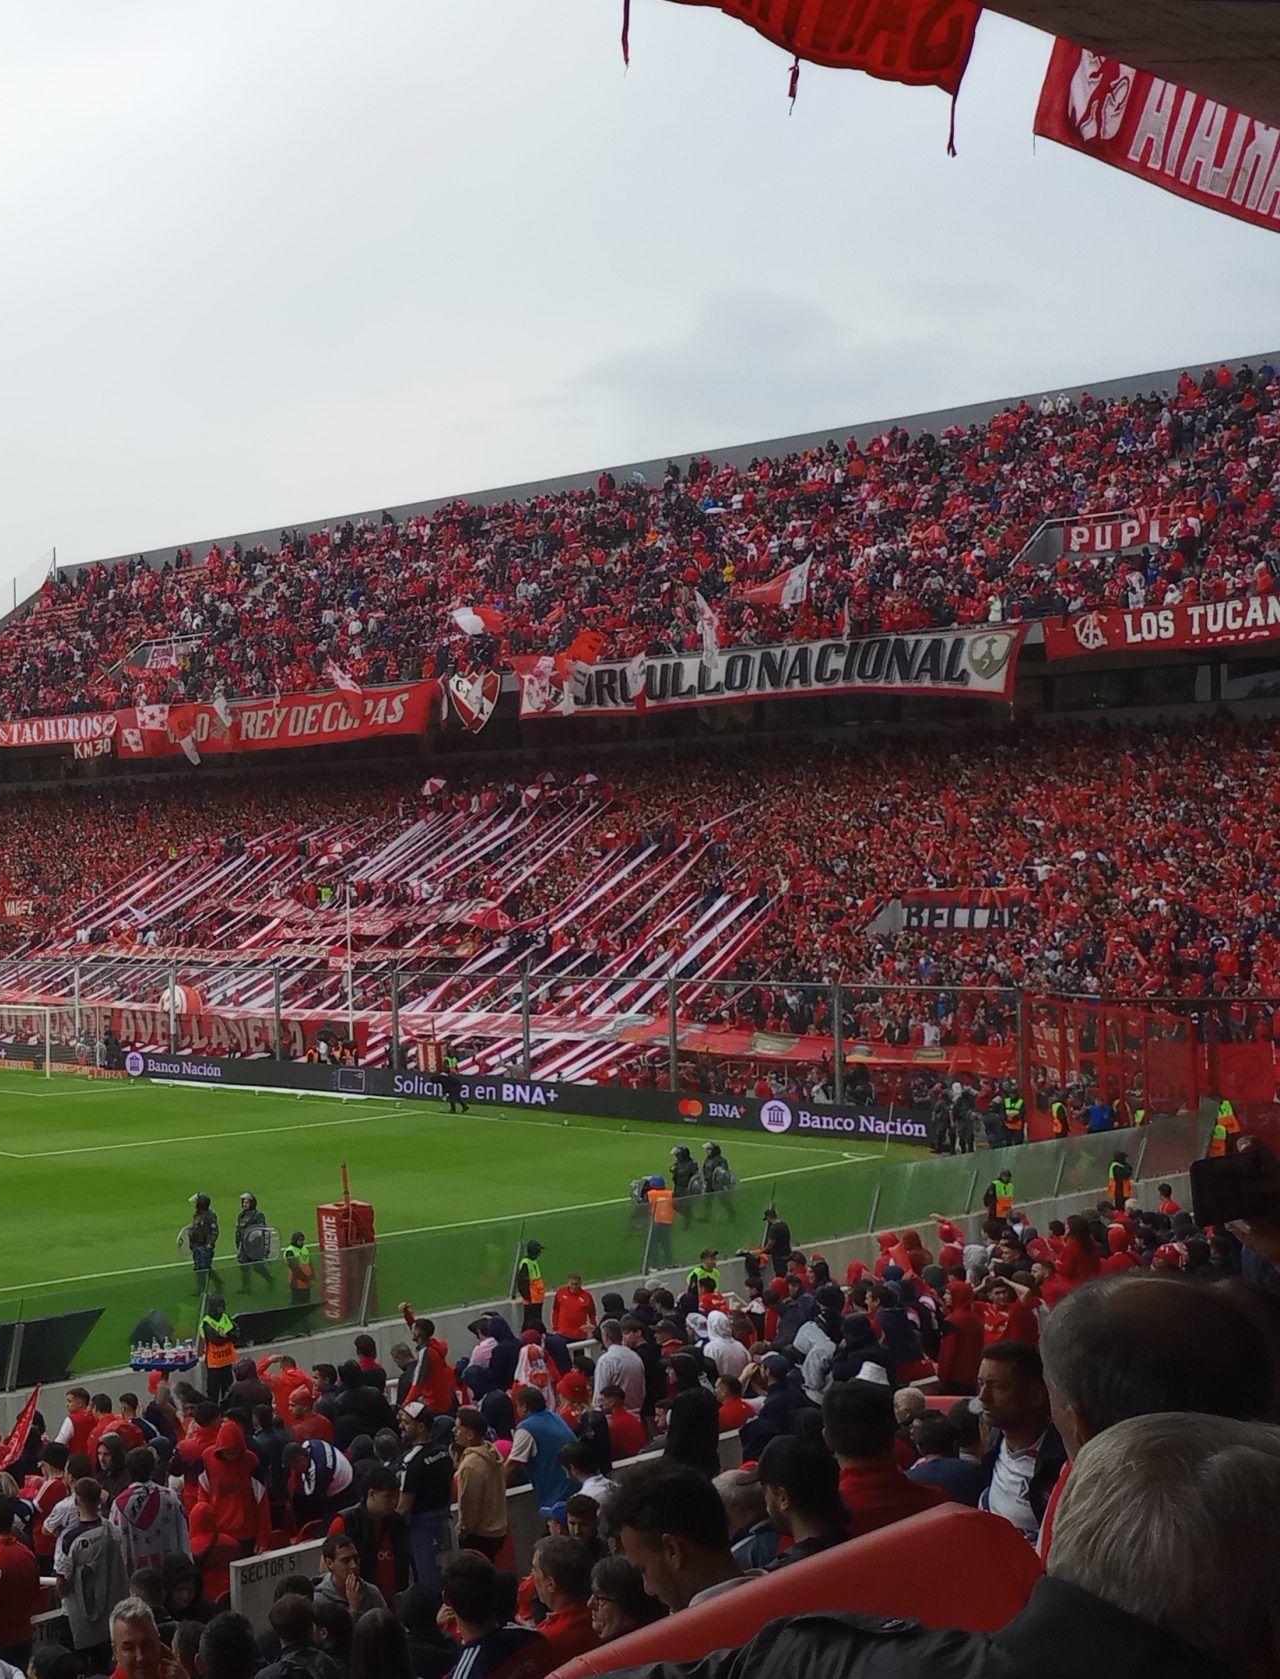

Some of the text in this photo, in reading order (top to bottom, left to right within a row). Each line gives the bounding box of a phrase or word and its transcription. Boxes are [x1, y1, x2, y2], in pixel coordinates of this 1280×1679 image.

[1123, 610, 1175, 643] LOS
[756, 636, 970, 688] NACIONAL
[10, 715, 101, 744] TACHEROS
[240, 705, 288, 740] REY
[289, 702, 320, 736] DE
[147, 1058, 221, 1077] Banco Nación
[475, 1084, 496, 1100] en
[502, 1083, 559, 1105] BNA+
[798, 1111, 928, 1138] Banco Nación
[240, 1557, 296, 1585] SECTOR 5
